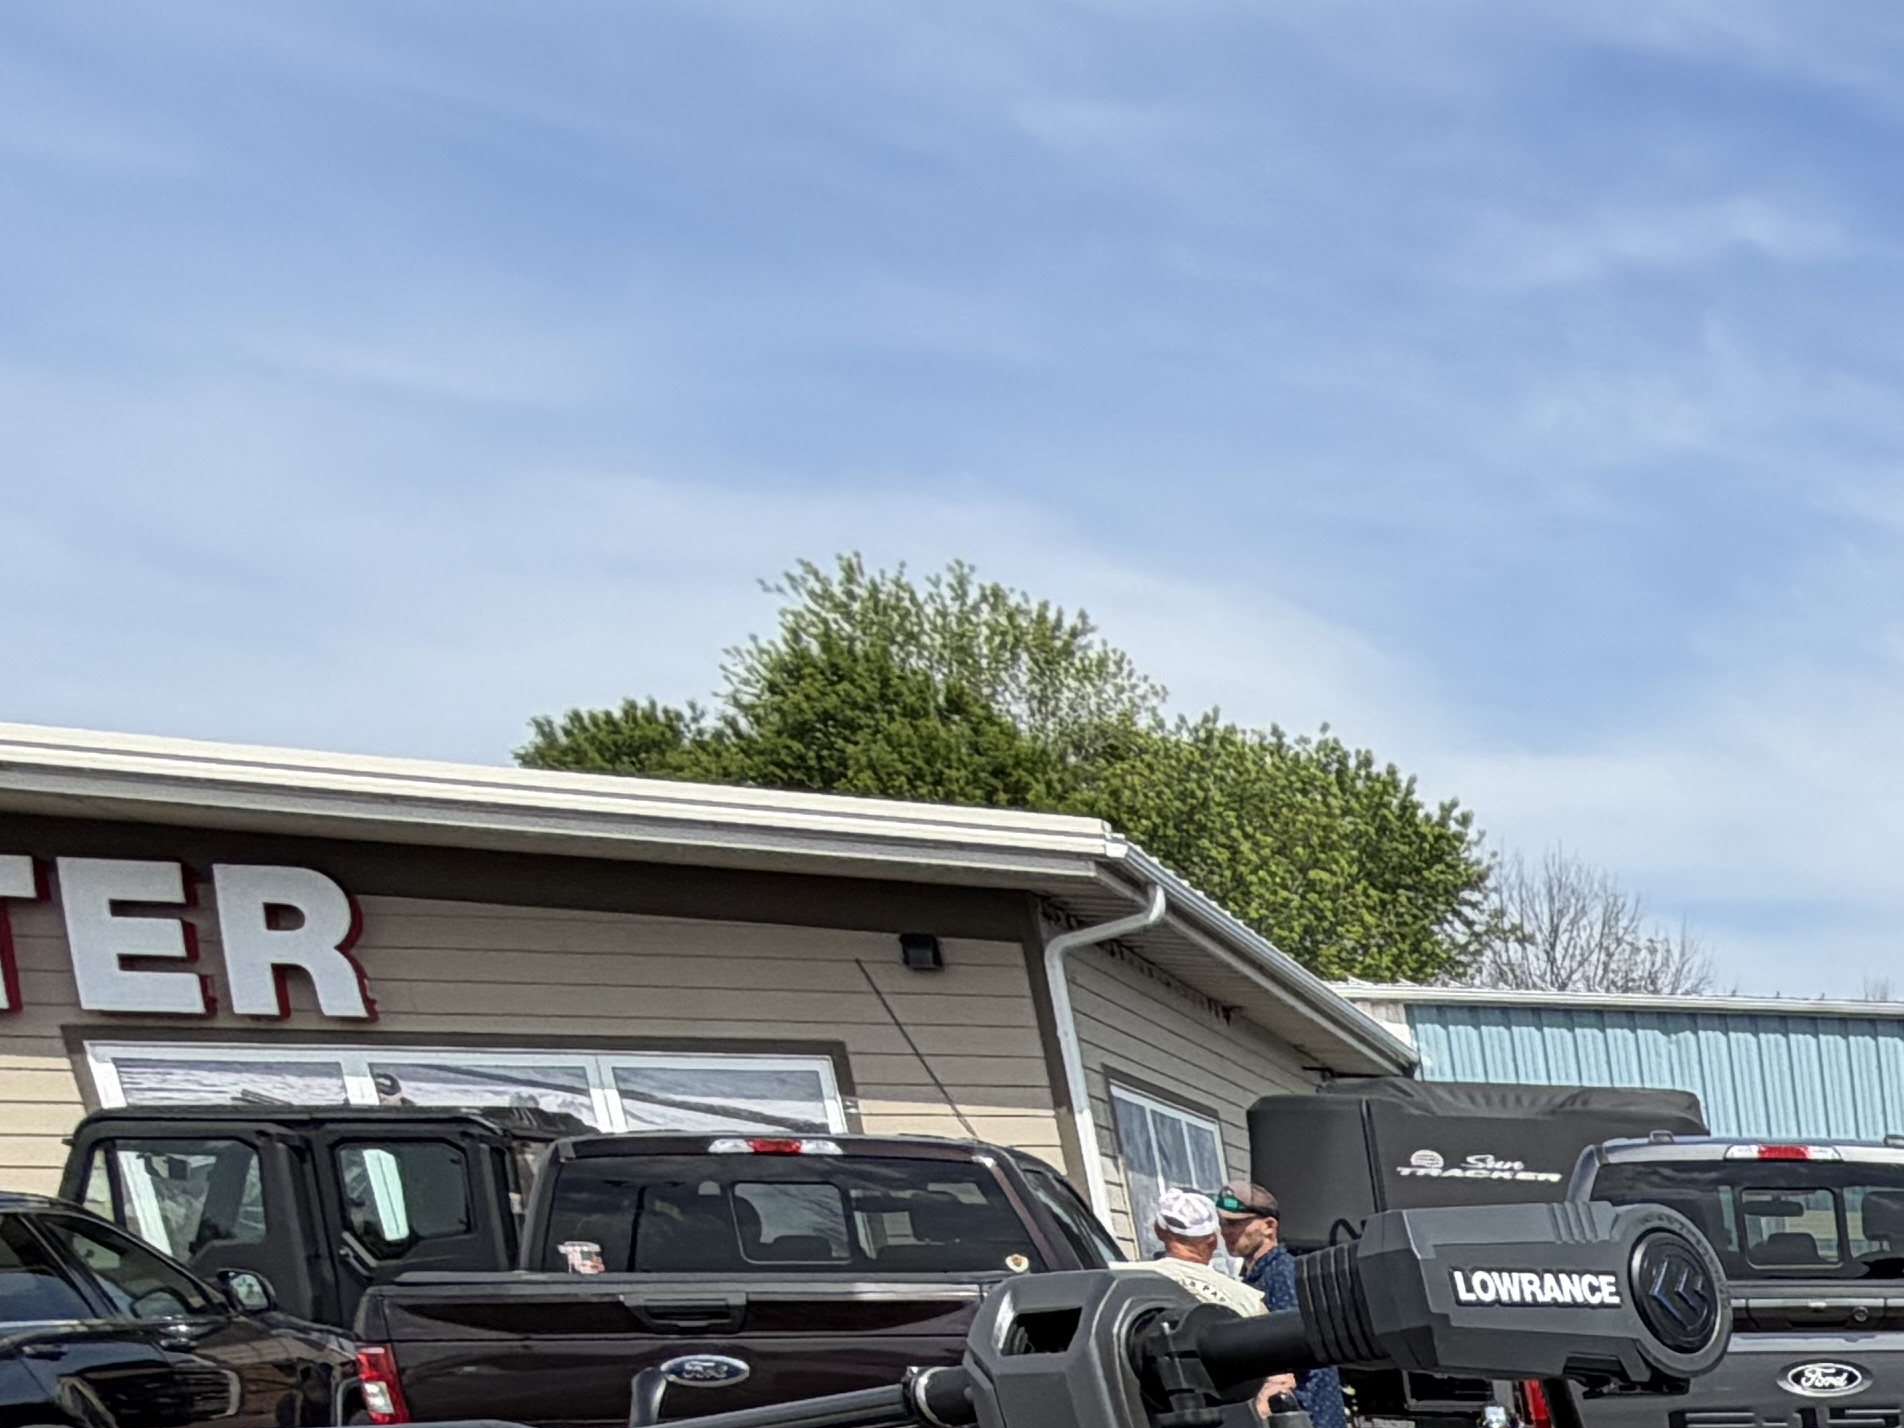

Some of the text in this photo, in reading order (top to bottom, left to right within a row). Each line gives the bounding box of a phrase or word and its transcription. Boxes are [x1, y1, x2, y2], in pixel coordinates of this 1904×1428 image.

[0, 855, 370, 1017] ER
[1453, 1270, 1621, 1304] LOWRANCE
[1801, 1367, 1848, 1389] Ford
